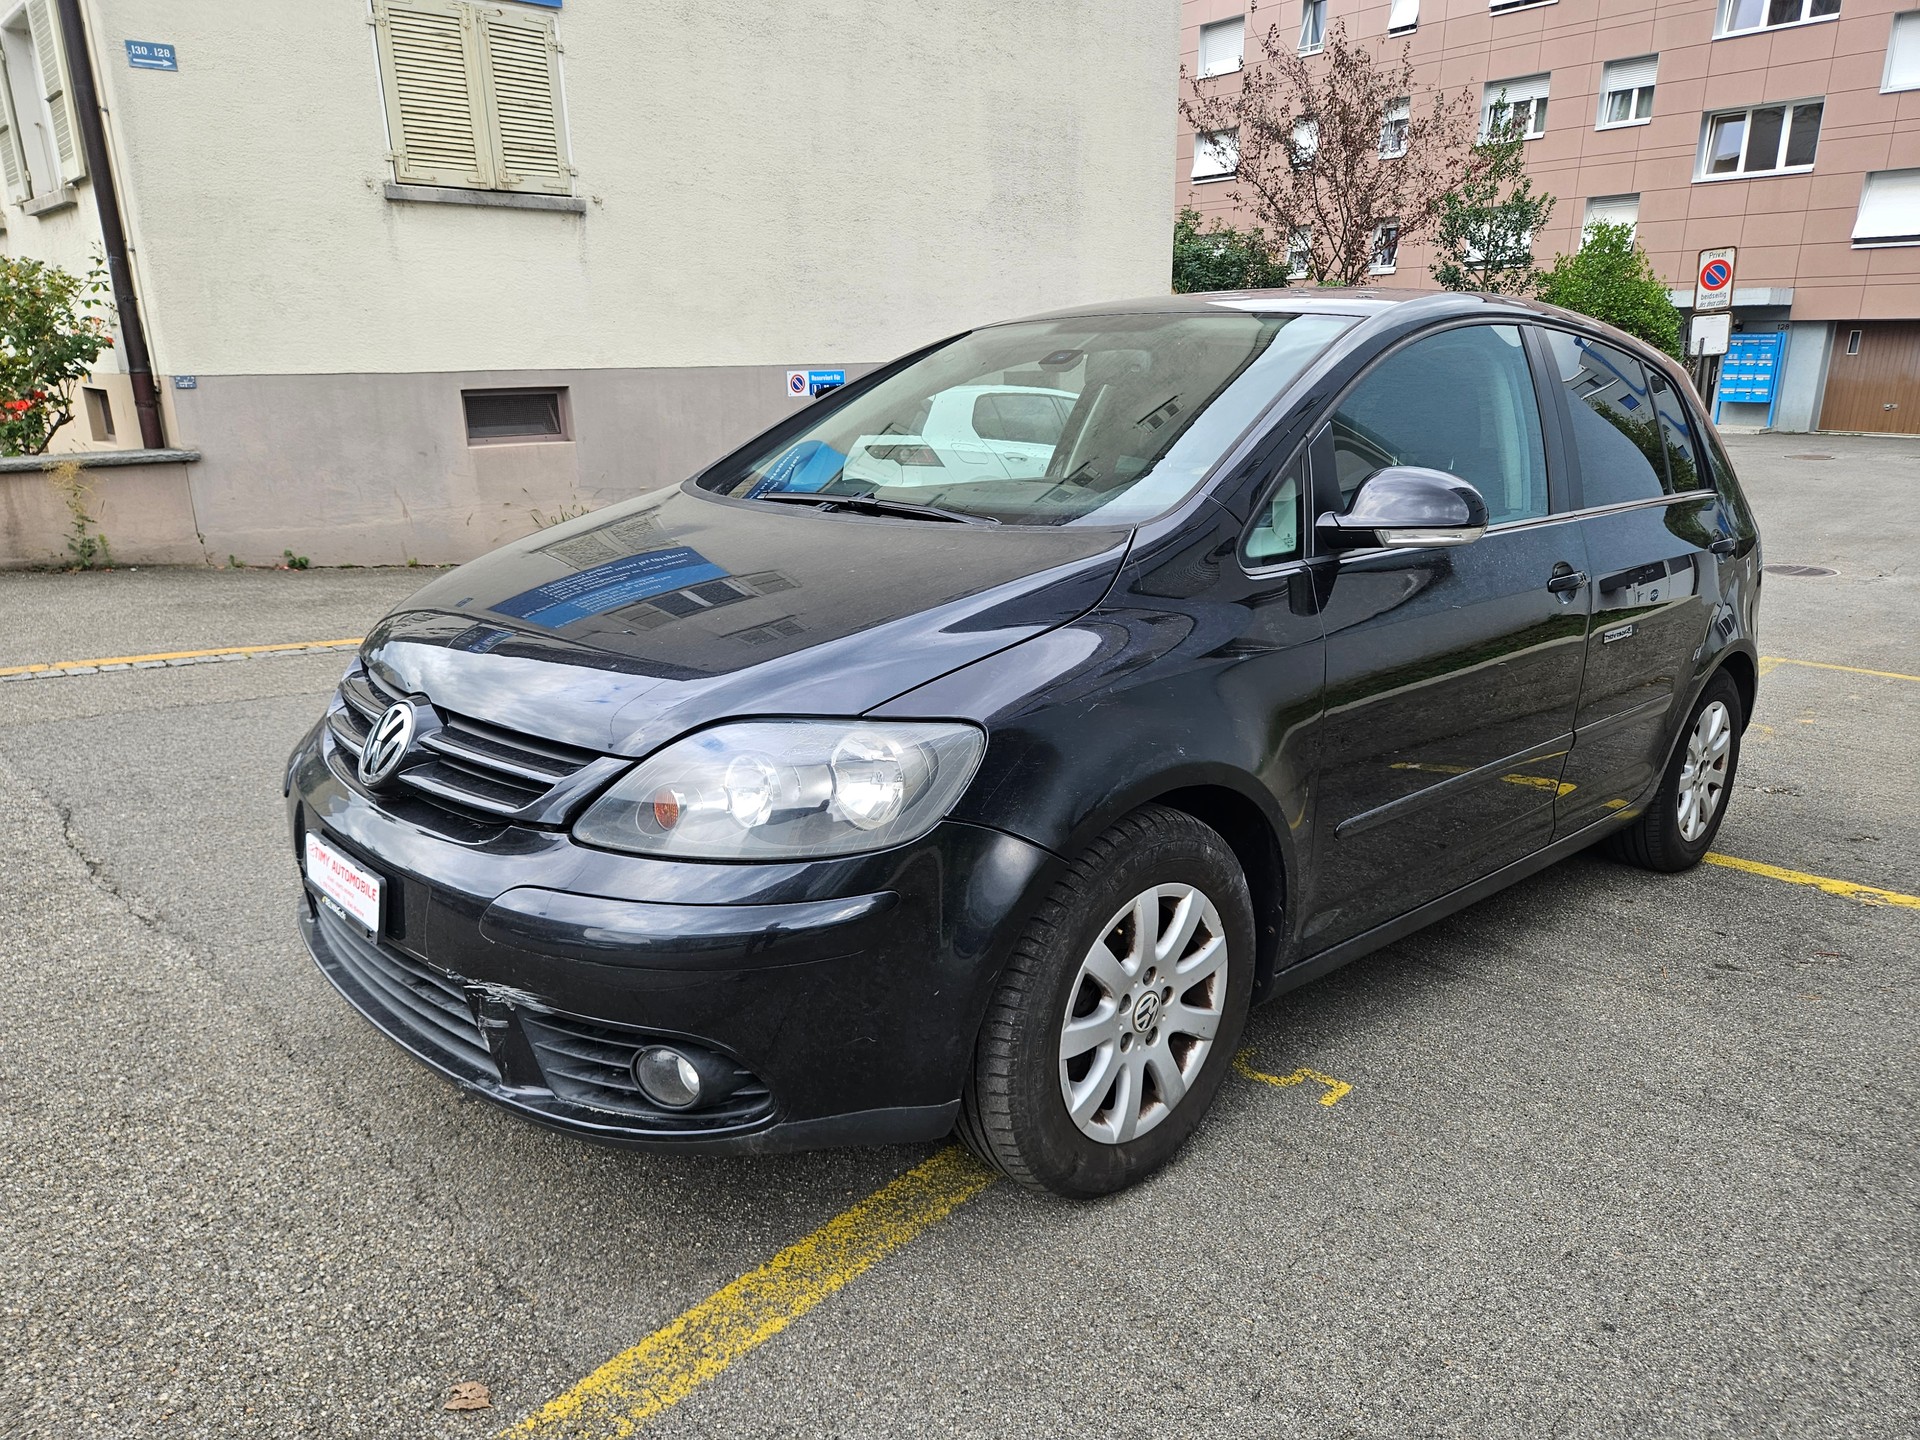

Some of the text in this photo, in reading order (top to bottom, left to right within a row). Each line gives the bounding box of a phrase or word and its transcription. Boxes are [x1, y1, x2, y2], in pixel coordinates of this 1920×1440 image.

[131, 45, 148, 55] 130
[153, 47, 171, 58] 128
[1709, 251, 1727, 259] Privat
[1700, 292, 1727, 300] beidseitig
[314, 846, 331, 867] TIMY
[332, 860, 377, 902] AUTOMOBILE
